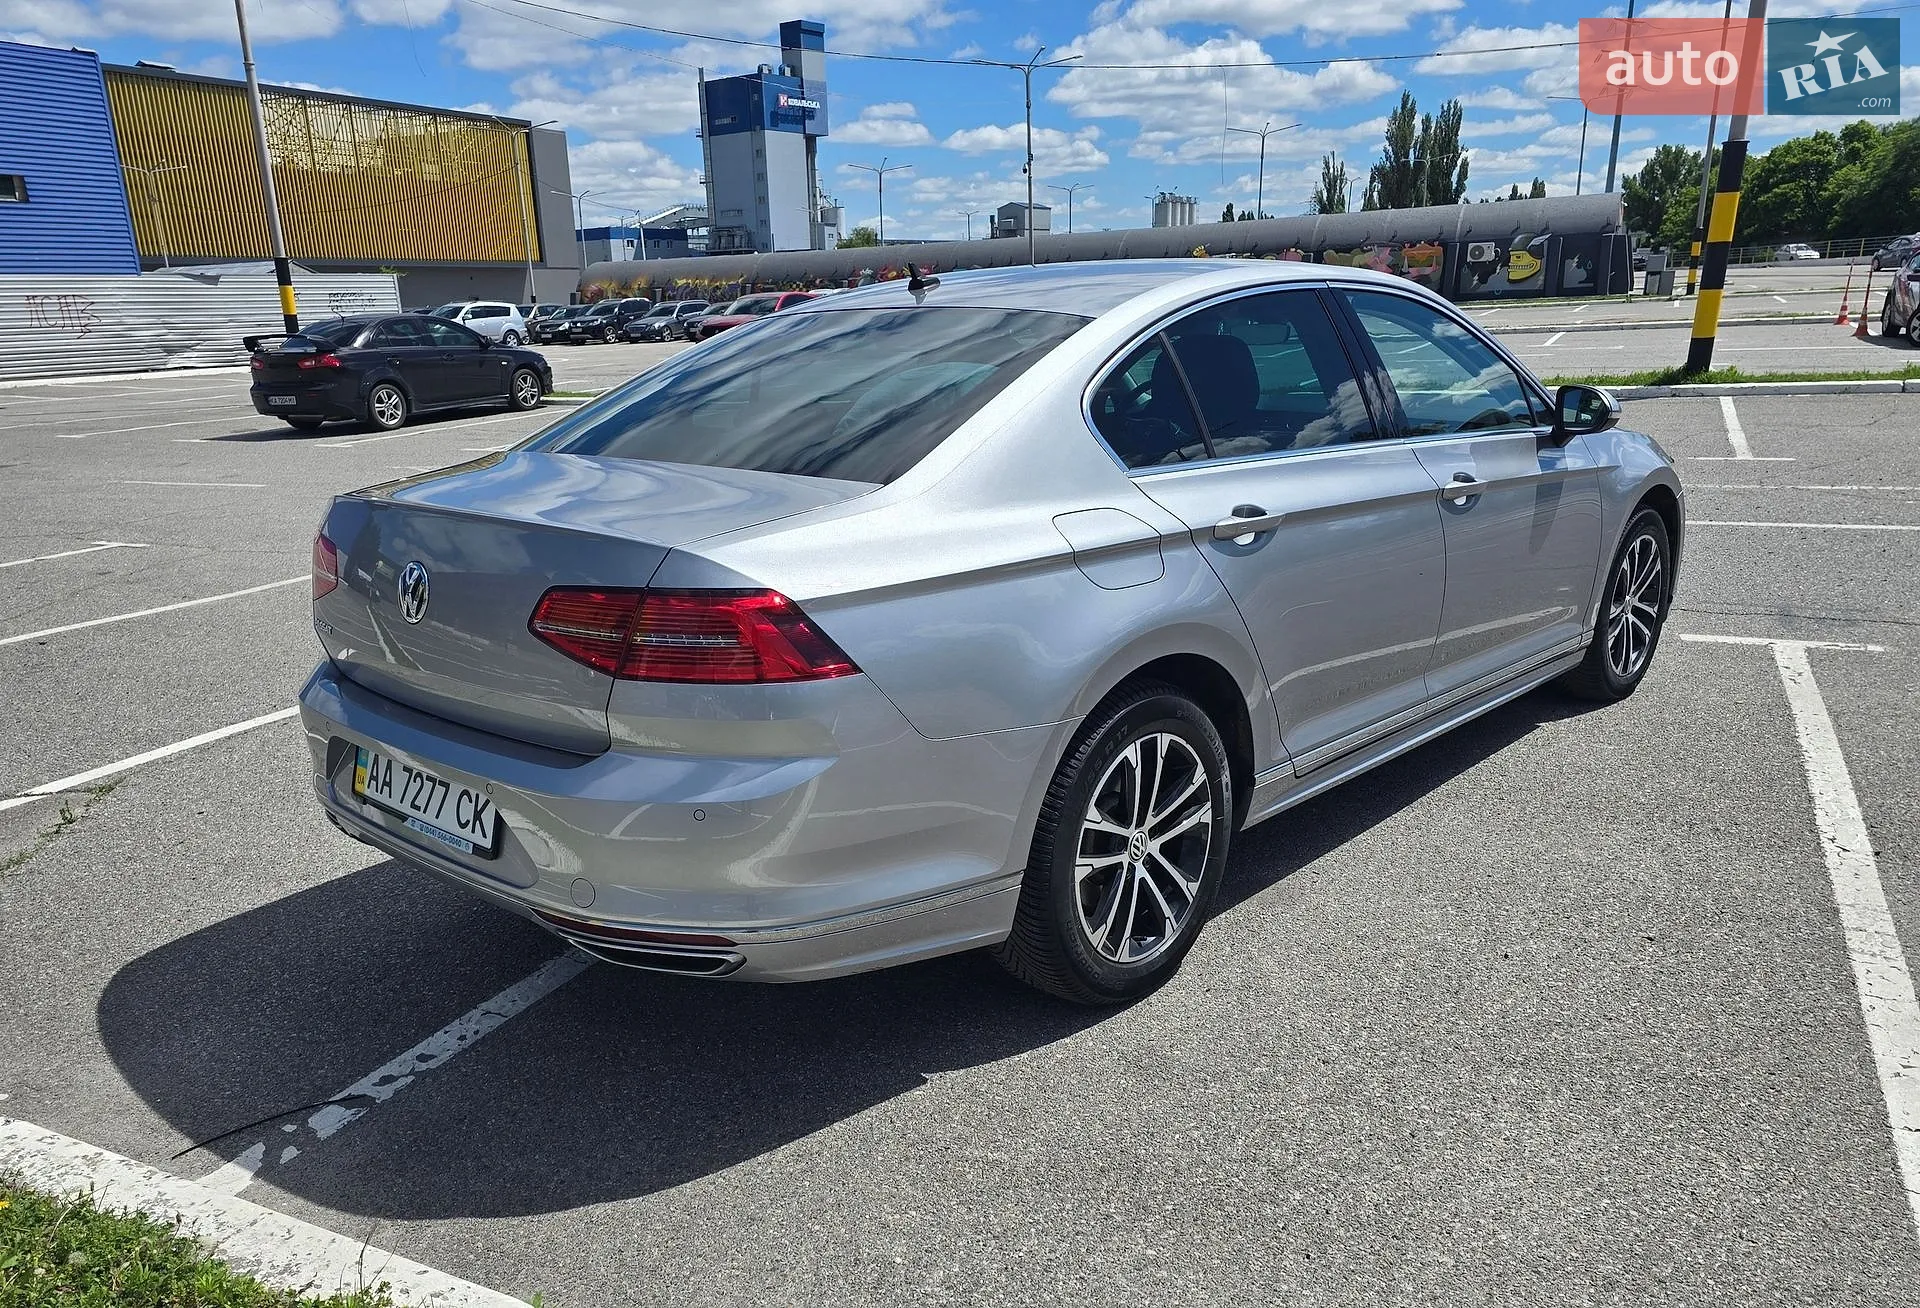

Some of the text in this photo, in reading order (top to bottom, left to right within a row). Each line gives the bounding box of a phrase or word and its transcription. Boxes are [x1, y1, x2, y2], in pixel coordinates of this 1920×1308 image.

[357, 774, 366, 786] UA
[367, 753, 491, 840] AA 7277 CK
